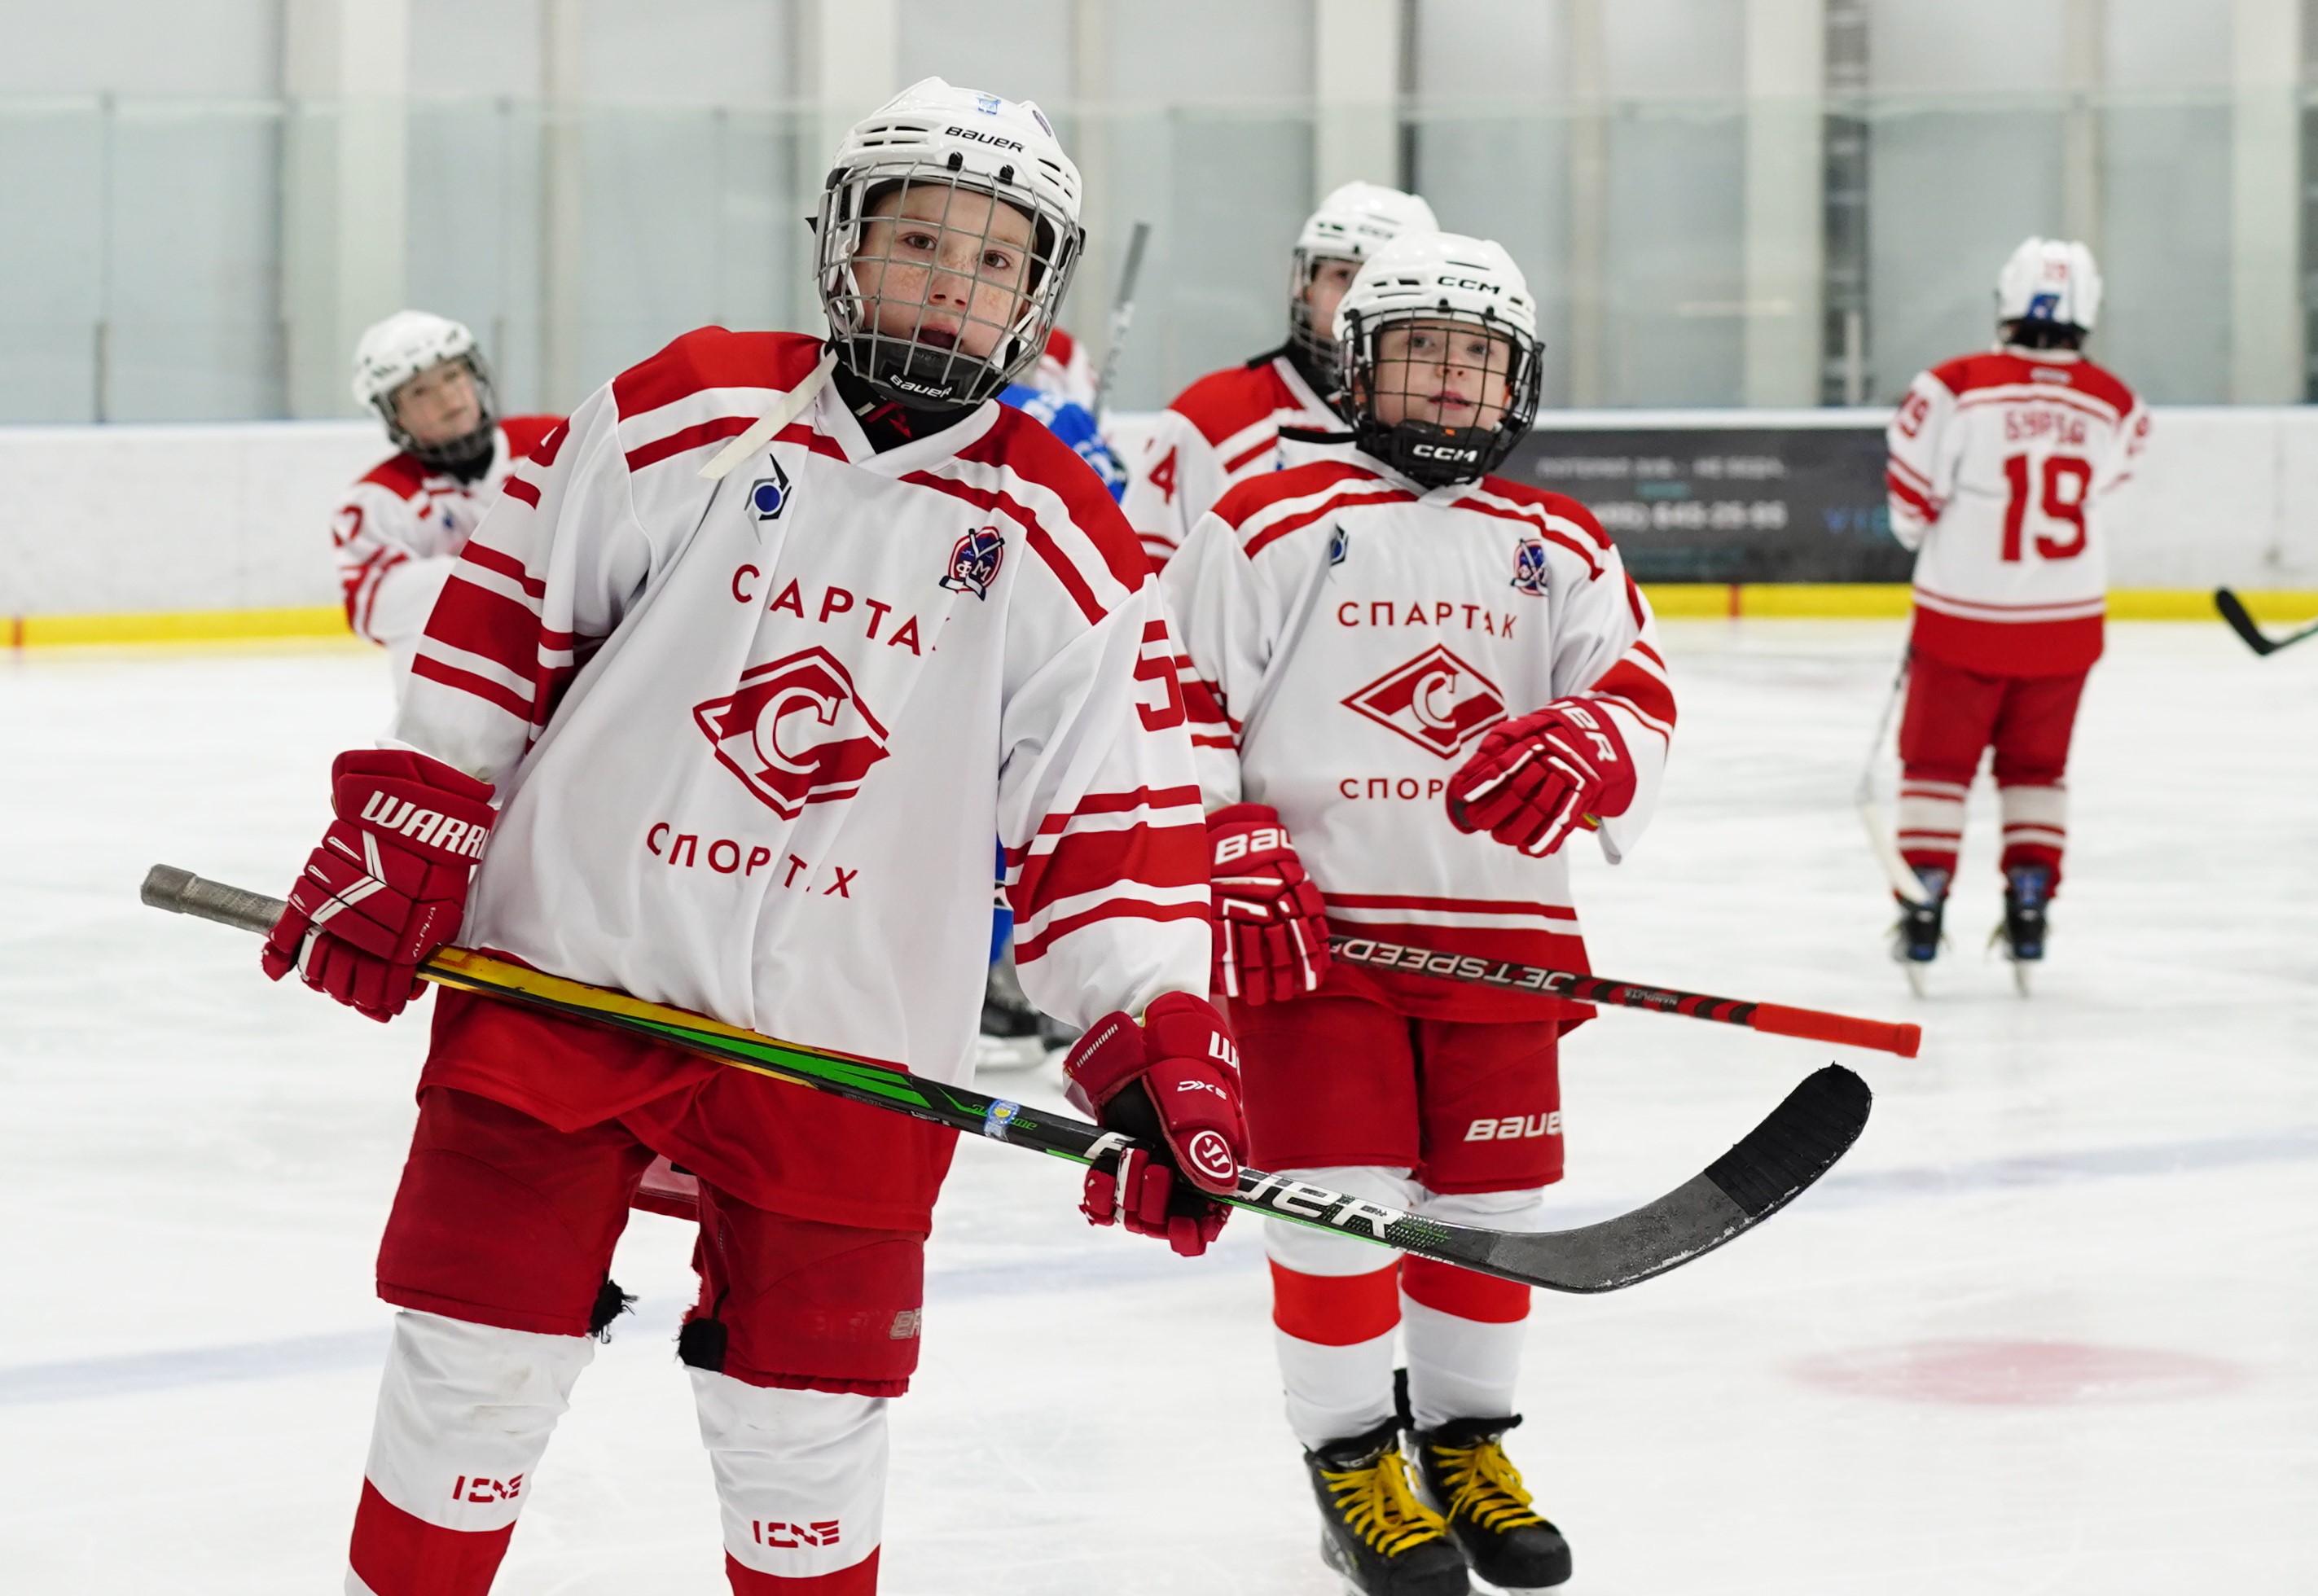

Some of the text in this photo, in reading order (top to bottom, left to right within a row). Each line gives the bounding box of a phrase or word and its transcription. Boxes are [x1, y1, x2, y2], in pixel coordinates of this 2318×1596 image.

[945, 125, 1025, 154] BAUER
[1438, 275, 1501, 296] CCM
[889, 374, 953, 398] BAUER
[1412, 443, 1477, 463] CCM
[2000, 453, 2092, 562] 19
[732, 563, 950, 656] САРТА
[1337, 601, 1517, 639] СПАРТАК
[1340, 778, 1443, 800] СПОР
[646, 822, 858, 899] СПОРТХ
[1214, 827, 1295, 866] BAU
[1342, 938, 1576, 991] JETSPEED
[1463, 1110, 1561, 1142] BAUE
